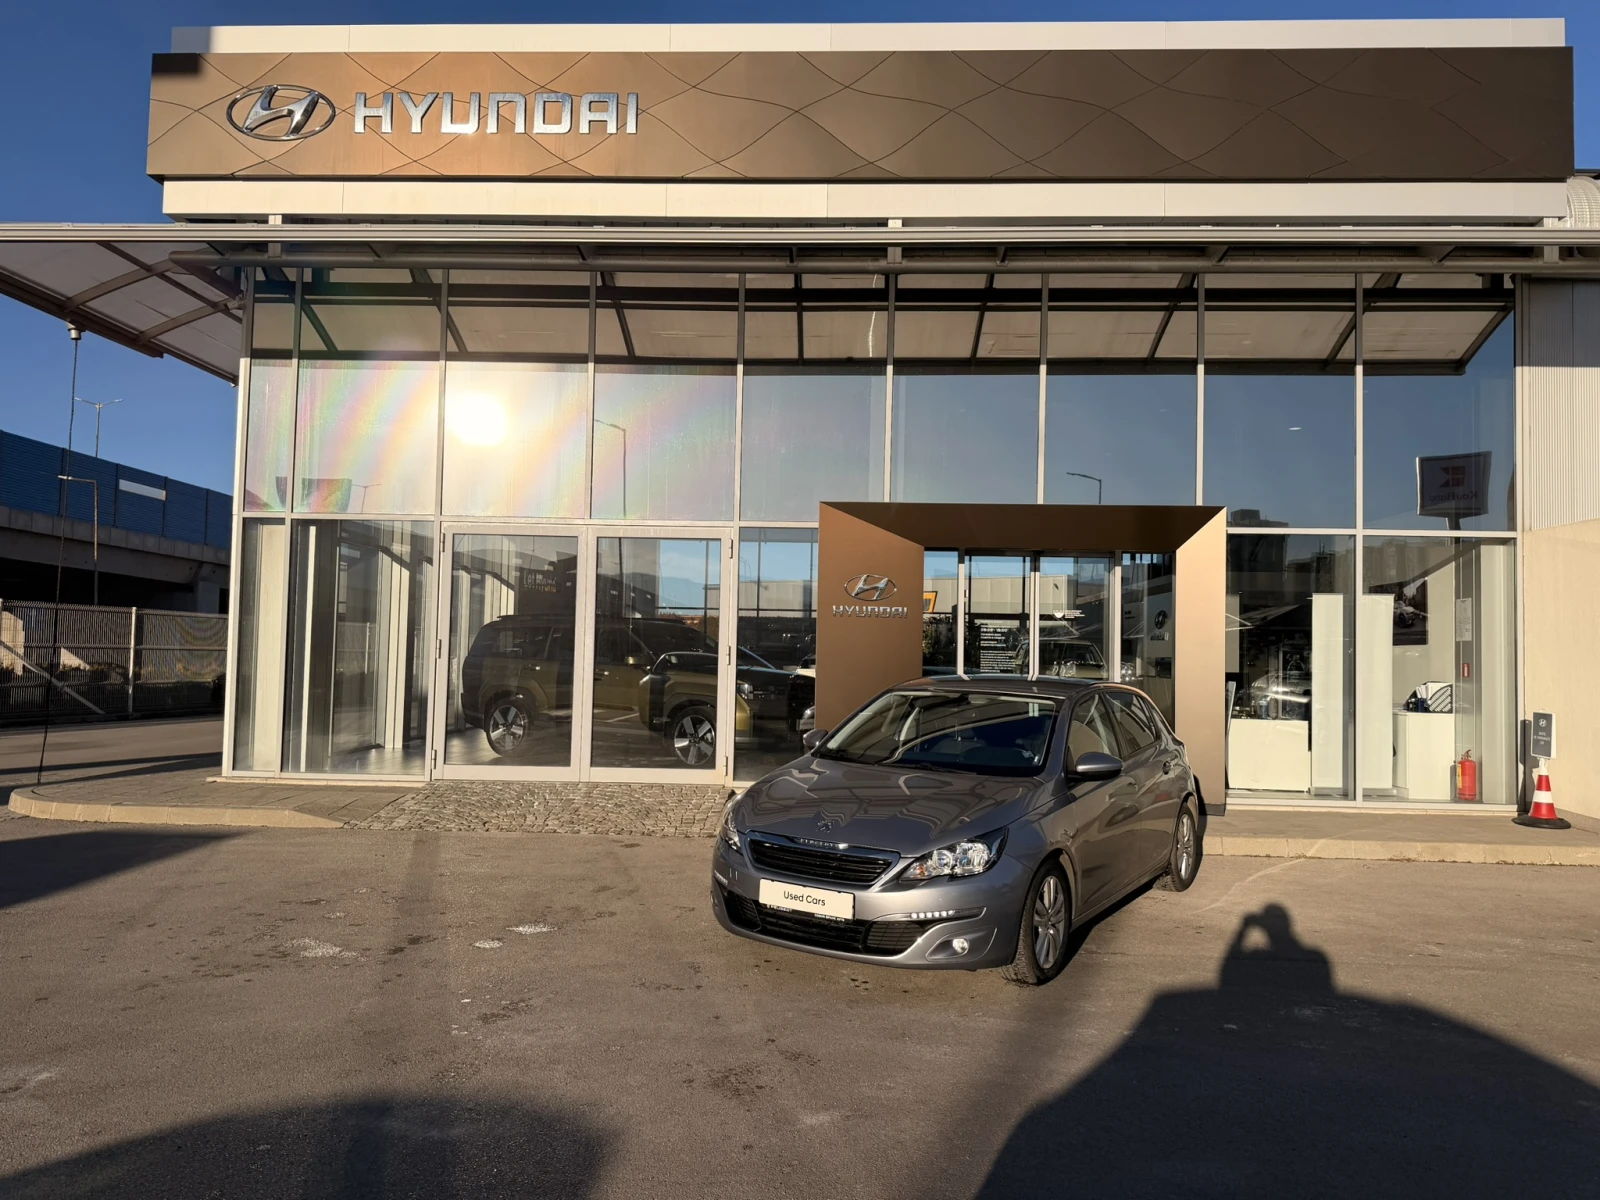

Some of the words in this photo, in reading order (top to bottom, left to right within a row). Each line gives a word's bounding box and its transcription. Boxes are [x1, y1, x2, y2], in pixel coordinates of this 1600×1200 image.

[354, 92, 637, 135] HYUNDAI
[832, 605, 908, 618] HYUNDAI
[783, 890, 804, 902] Used
[805, 895, 826, 906] Cars
